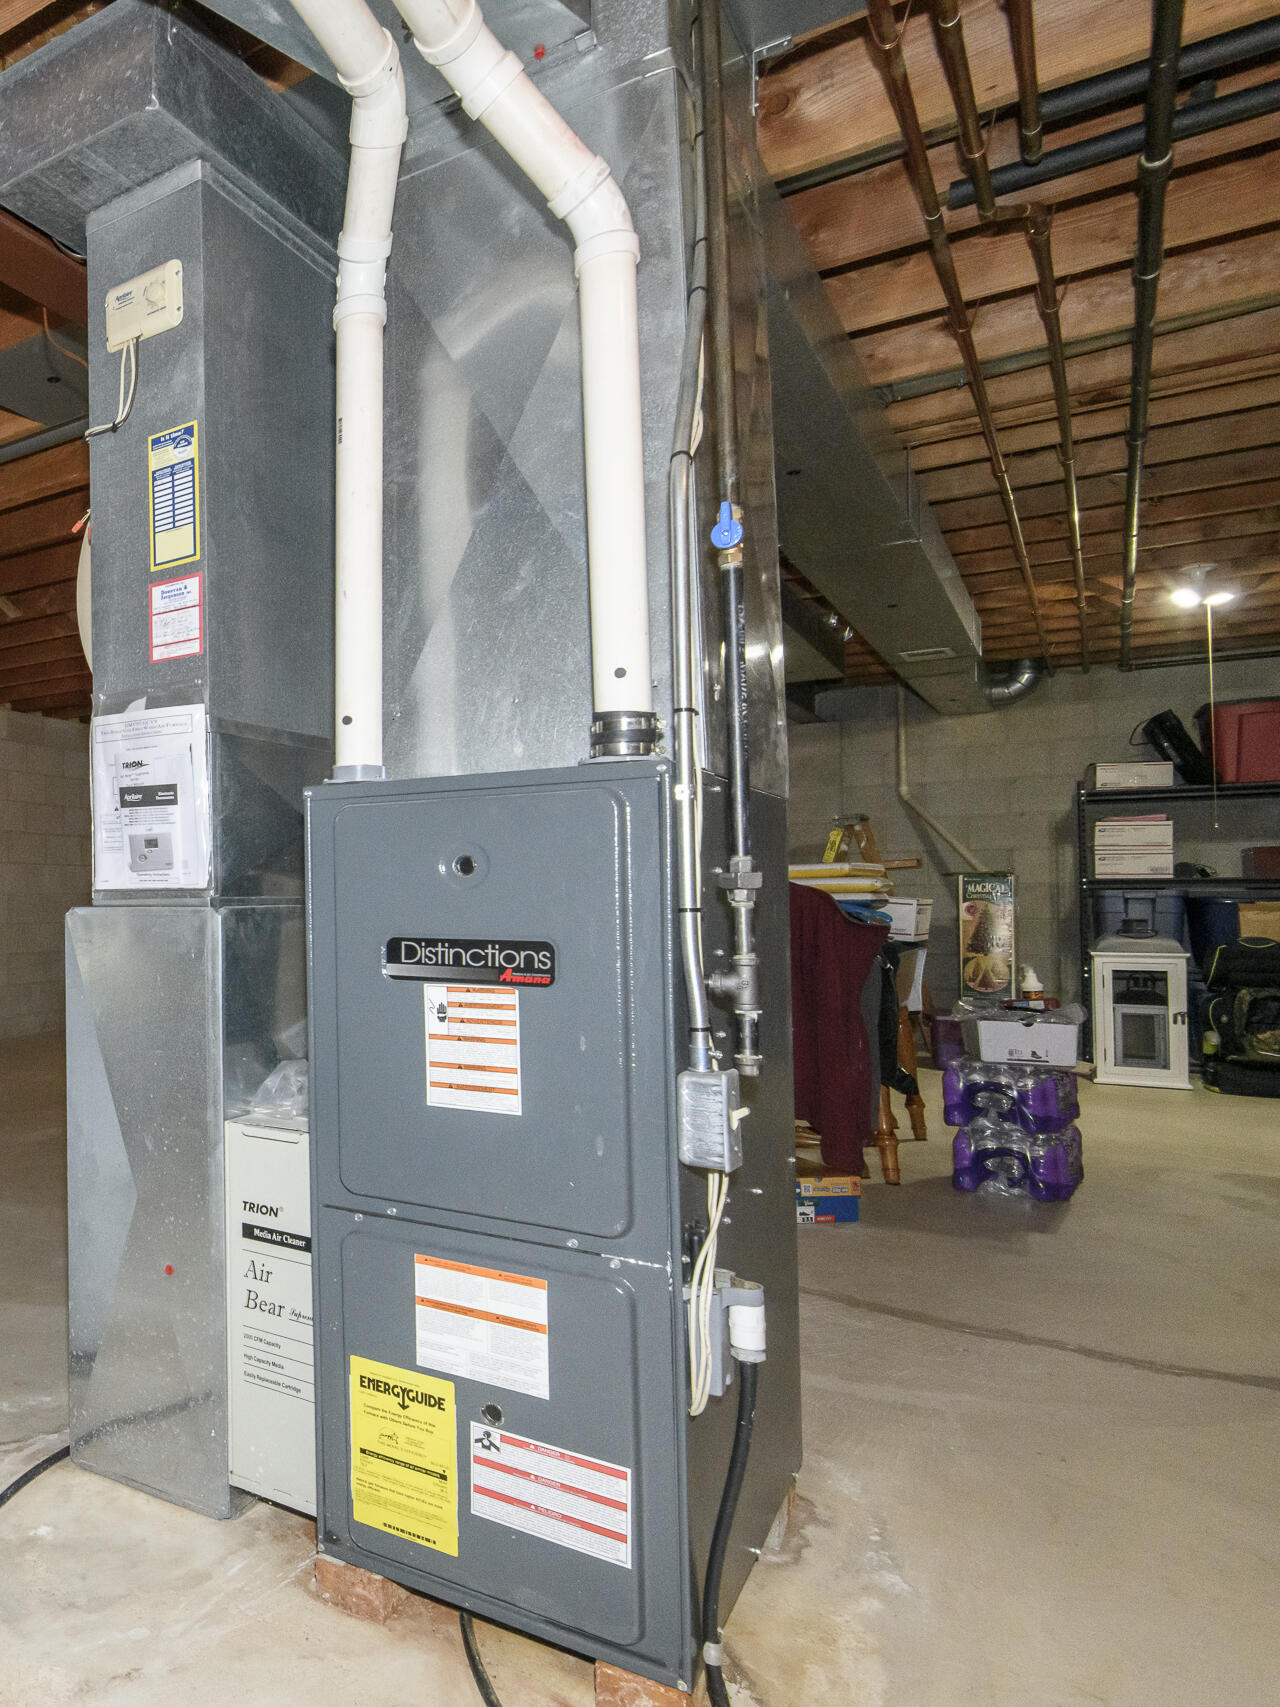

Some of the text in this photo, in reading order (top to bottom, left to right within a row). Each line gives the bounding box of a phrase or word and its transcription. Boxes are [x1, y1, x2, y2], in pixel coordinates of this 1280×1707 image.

[122, 760, 143, 769] TRION
[401, 941, 552, 970] Distinctions
[499, 968, 551, 984] Amana
[242, 1200, 279, 1218] TRION
[253, 1228, 306, 1247] Media Air Cleaner
[244, 1260, 273, 1283] Air
[244, 1288, 285, 1318] Bear
[359, 1374, 446, 1412] ENERGYGUIDE
